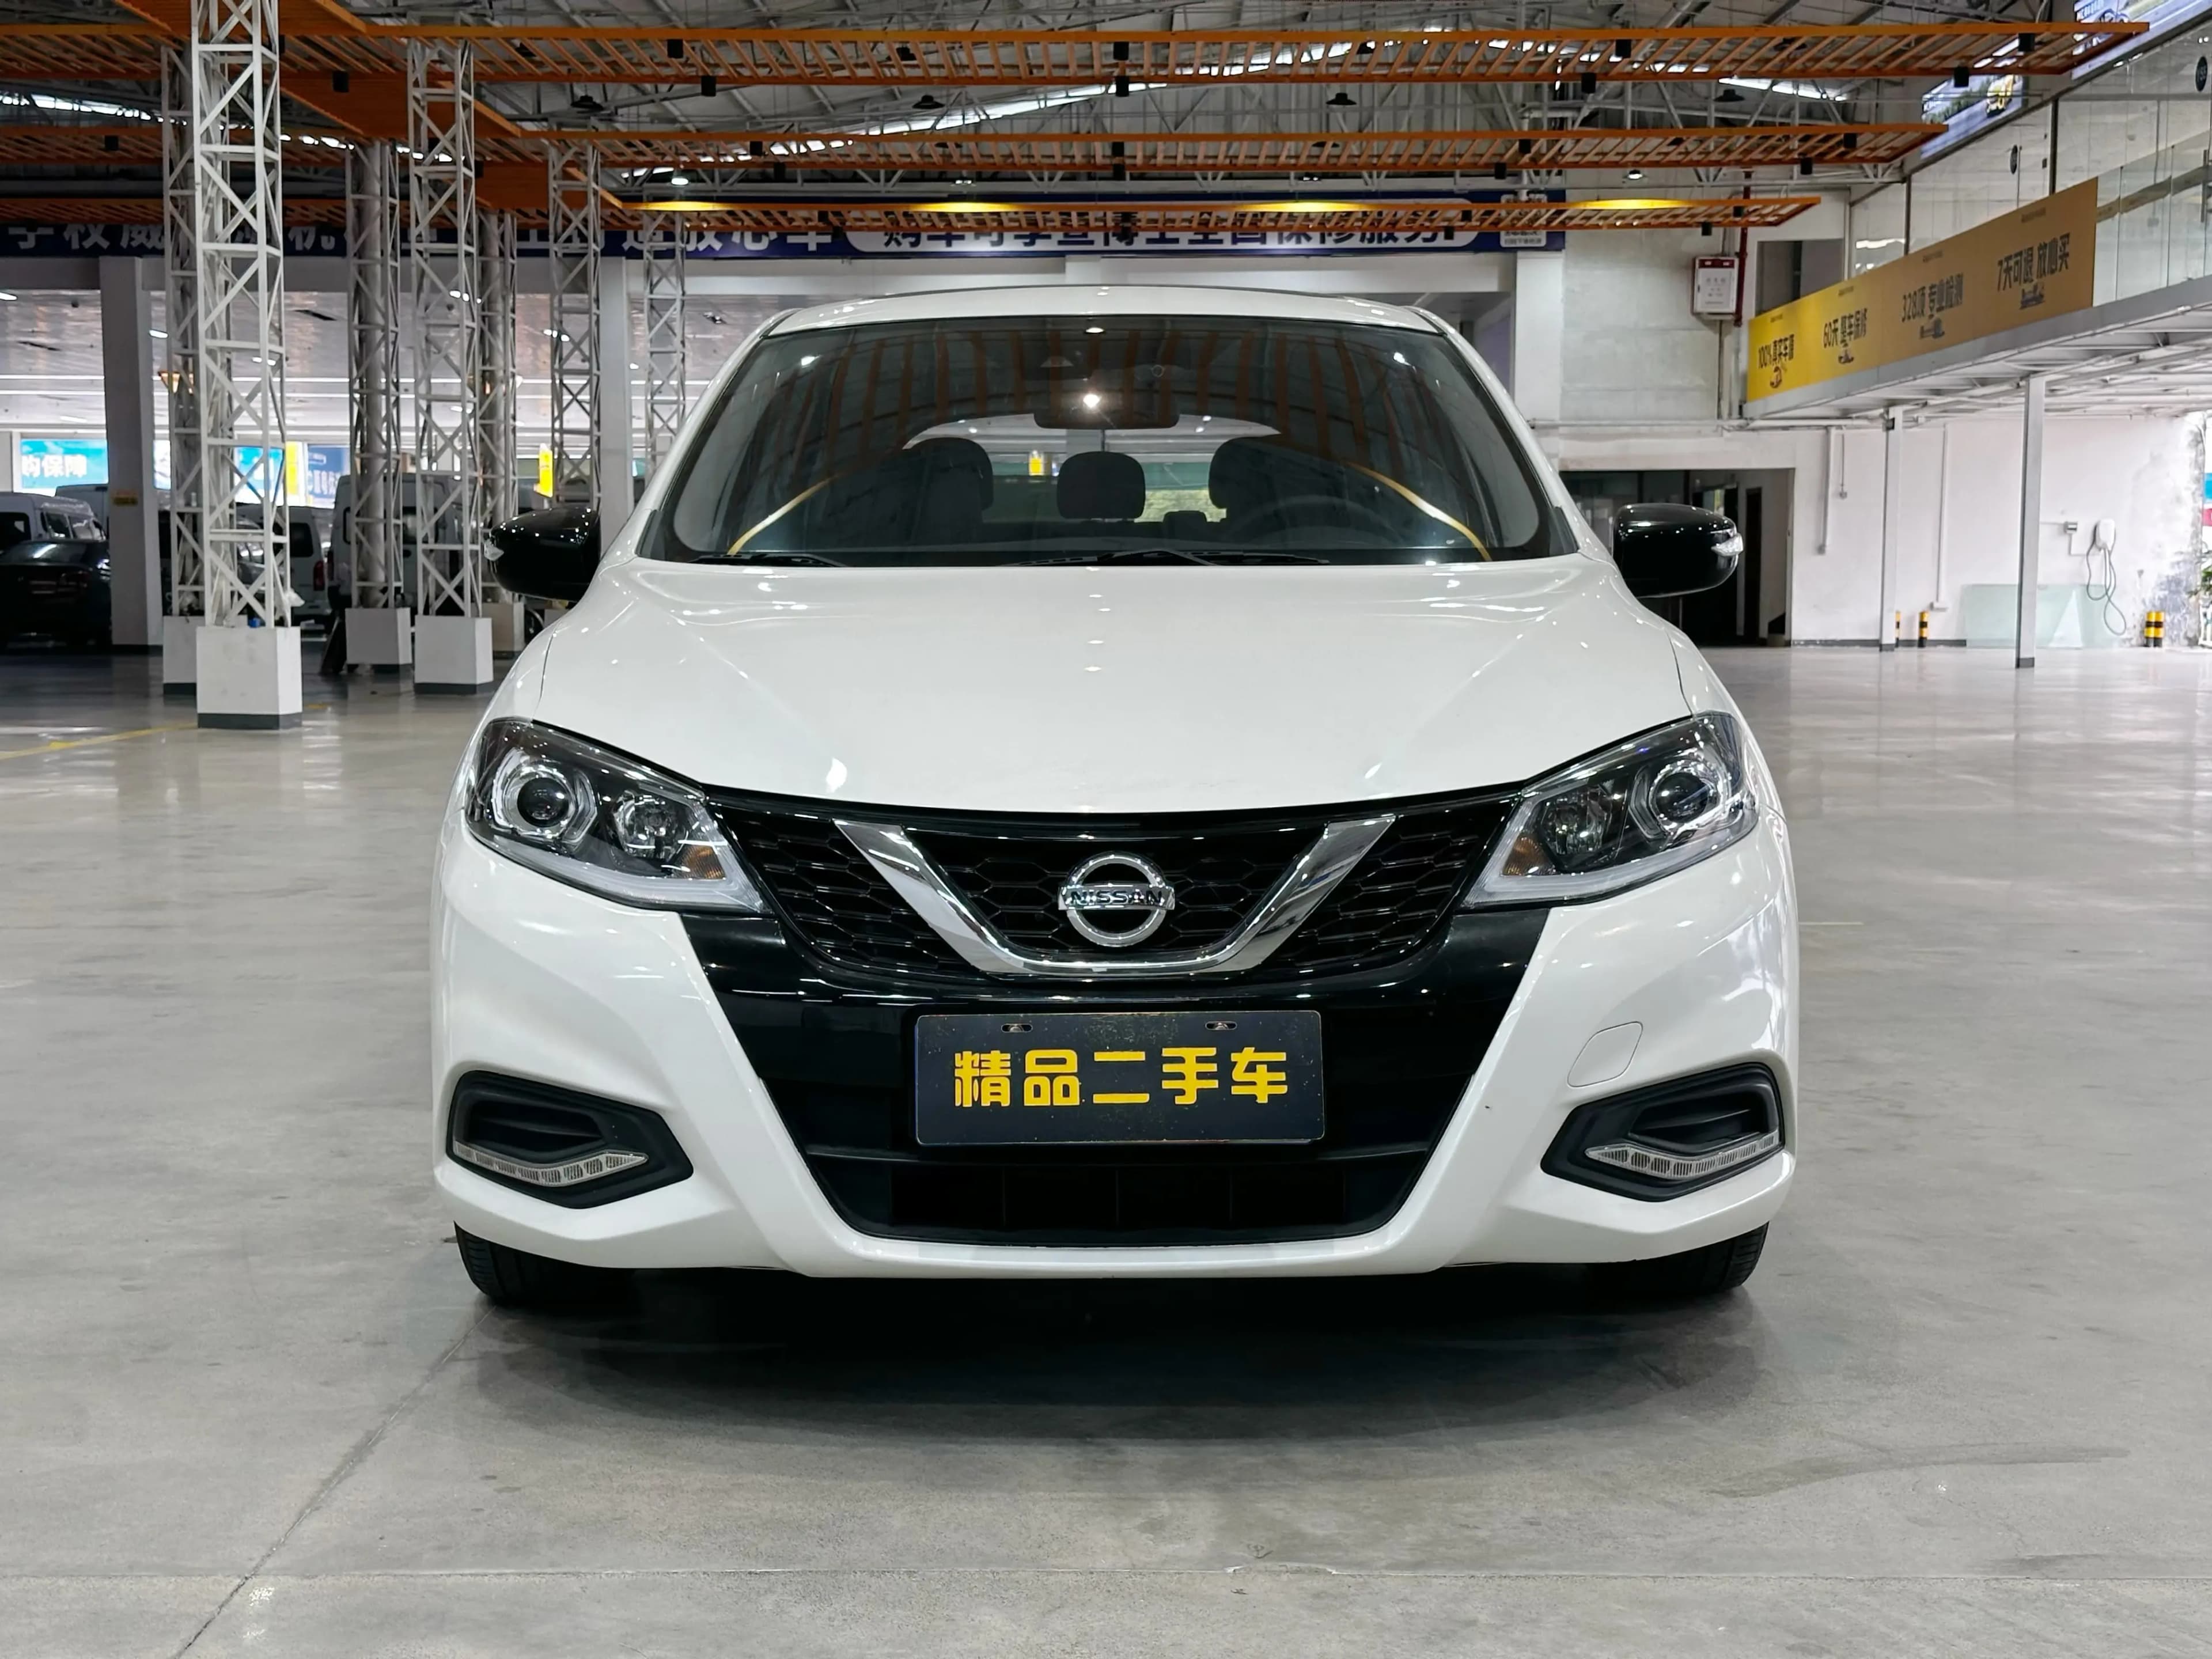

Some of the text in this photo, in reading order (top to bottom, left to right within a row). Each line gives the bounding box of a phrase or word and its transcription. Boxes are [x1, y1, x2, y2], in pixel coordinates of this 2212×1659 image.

[1070, 890, 1164, 906] NISSAN
[954, 1047, 1289, 1107] 精品二手车
